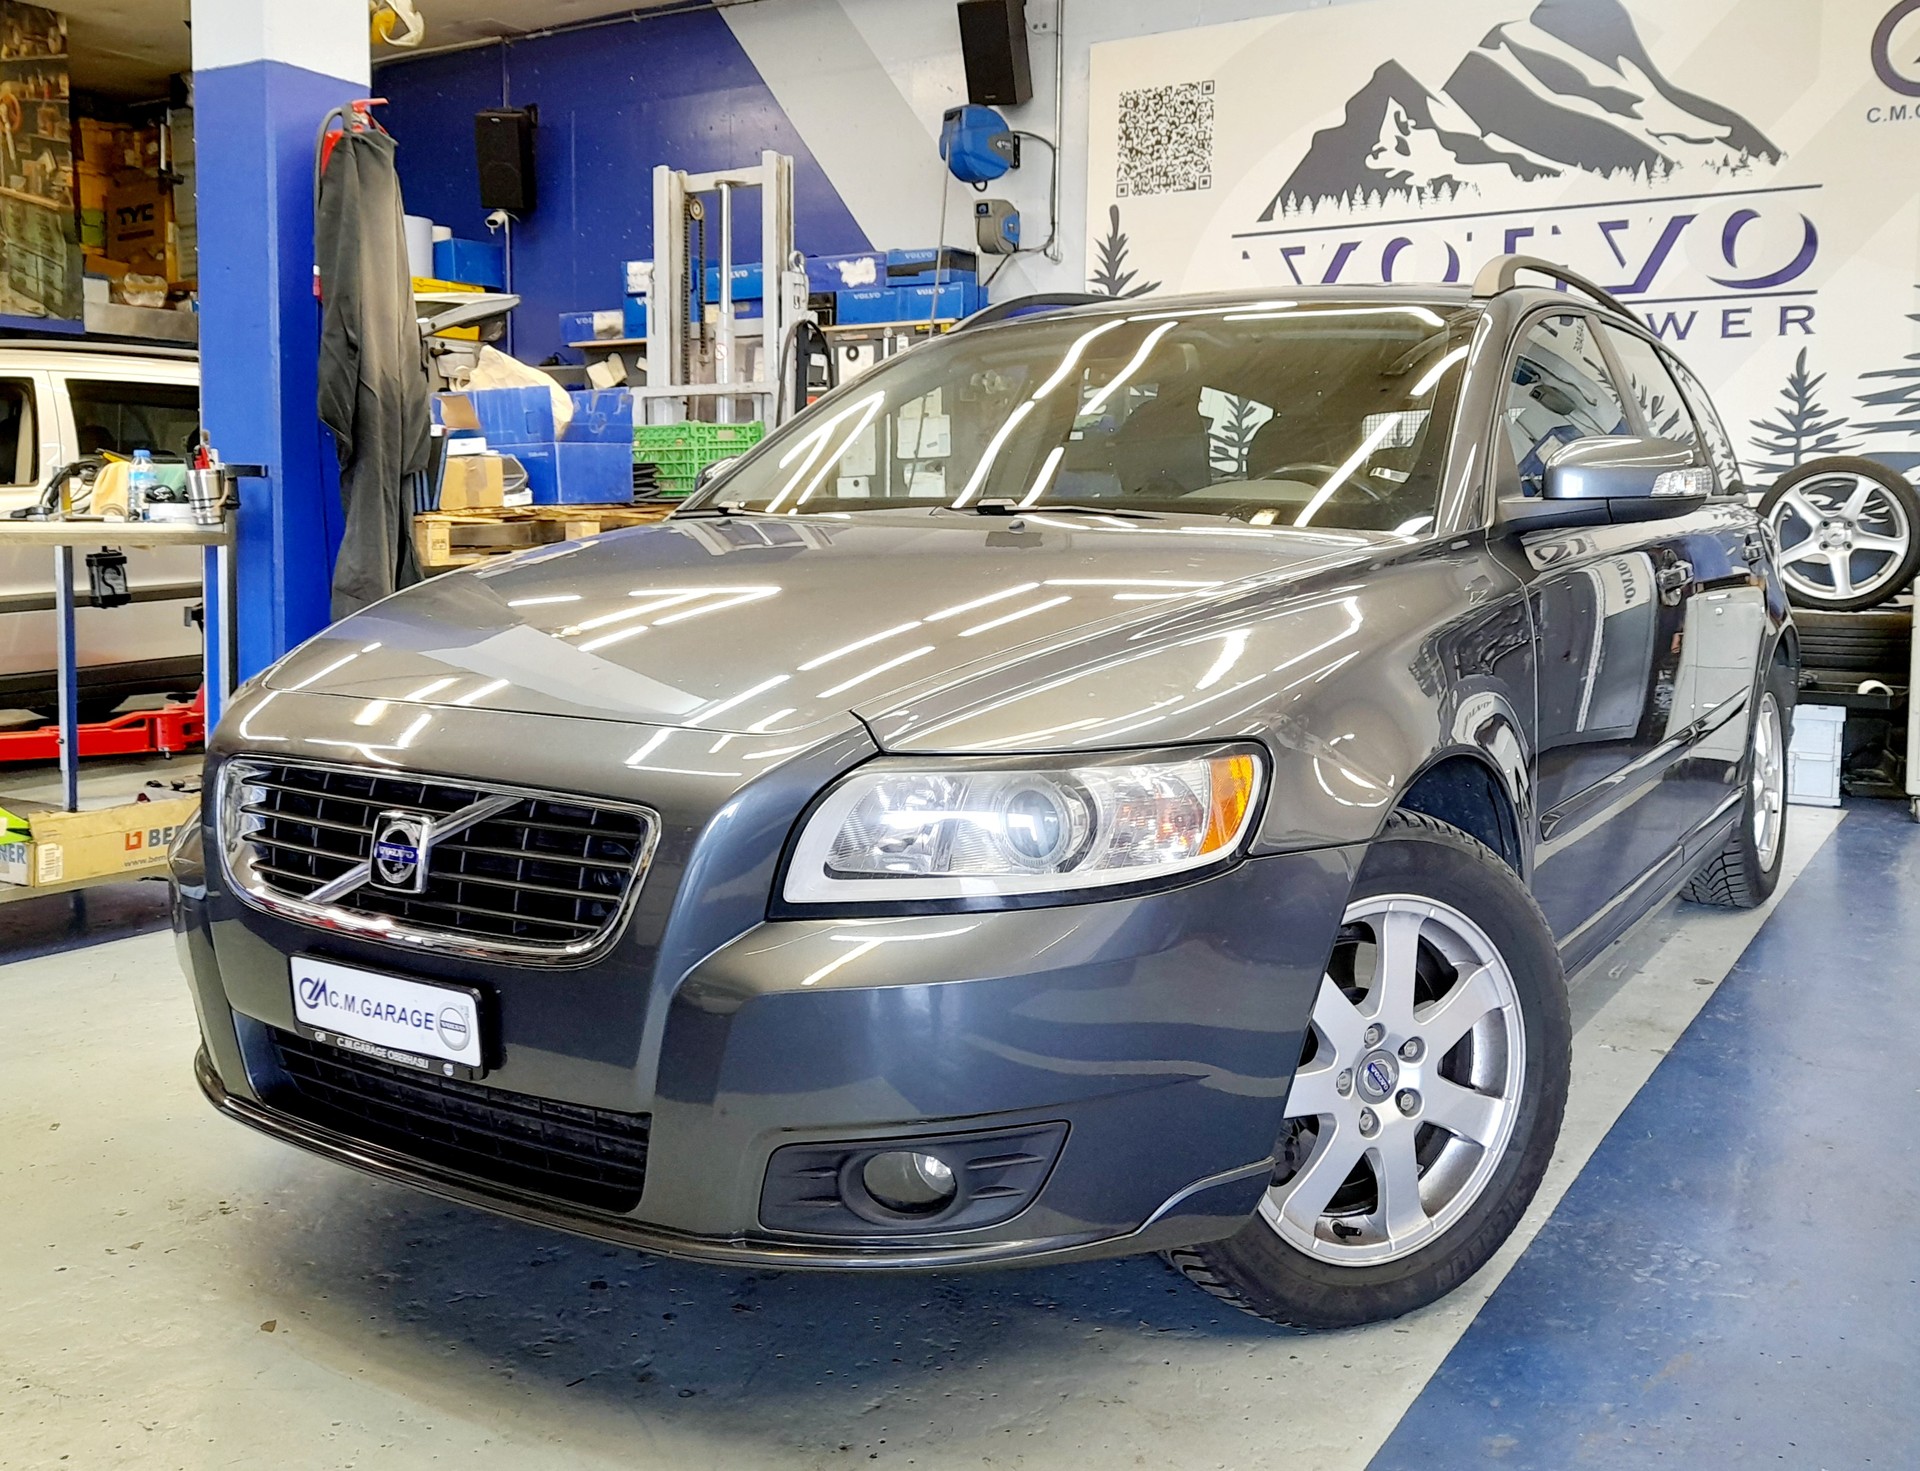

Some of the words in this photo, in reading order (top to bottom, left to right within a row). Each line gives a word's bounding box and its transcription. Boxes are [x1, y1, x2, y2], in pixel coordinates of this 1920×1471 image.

[1866, 104, 1920, 123] C.M.
[904, 251, 933, 260] VOLVO
[853, 291, 881, 300] VOLVO
[148, 824, 184, 847] BE
[377, 845, 416, 860] VOLVO
